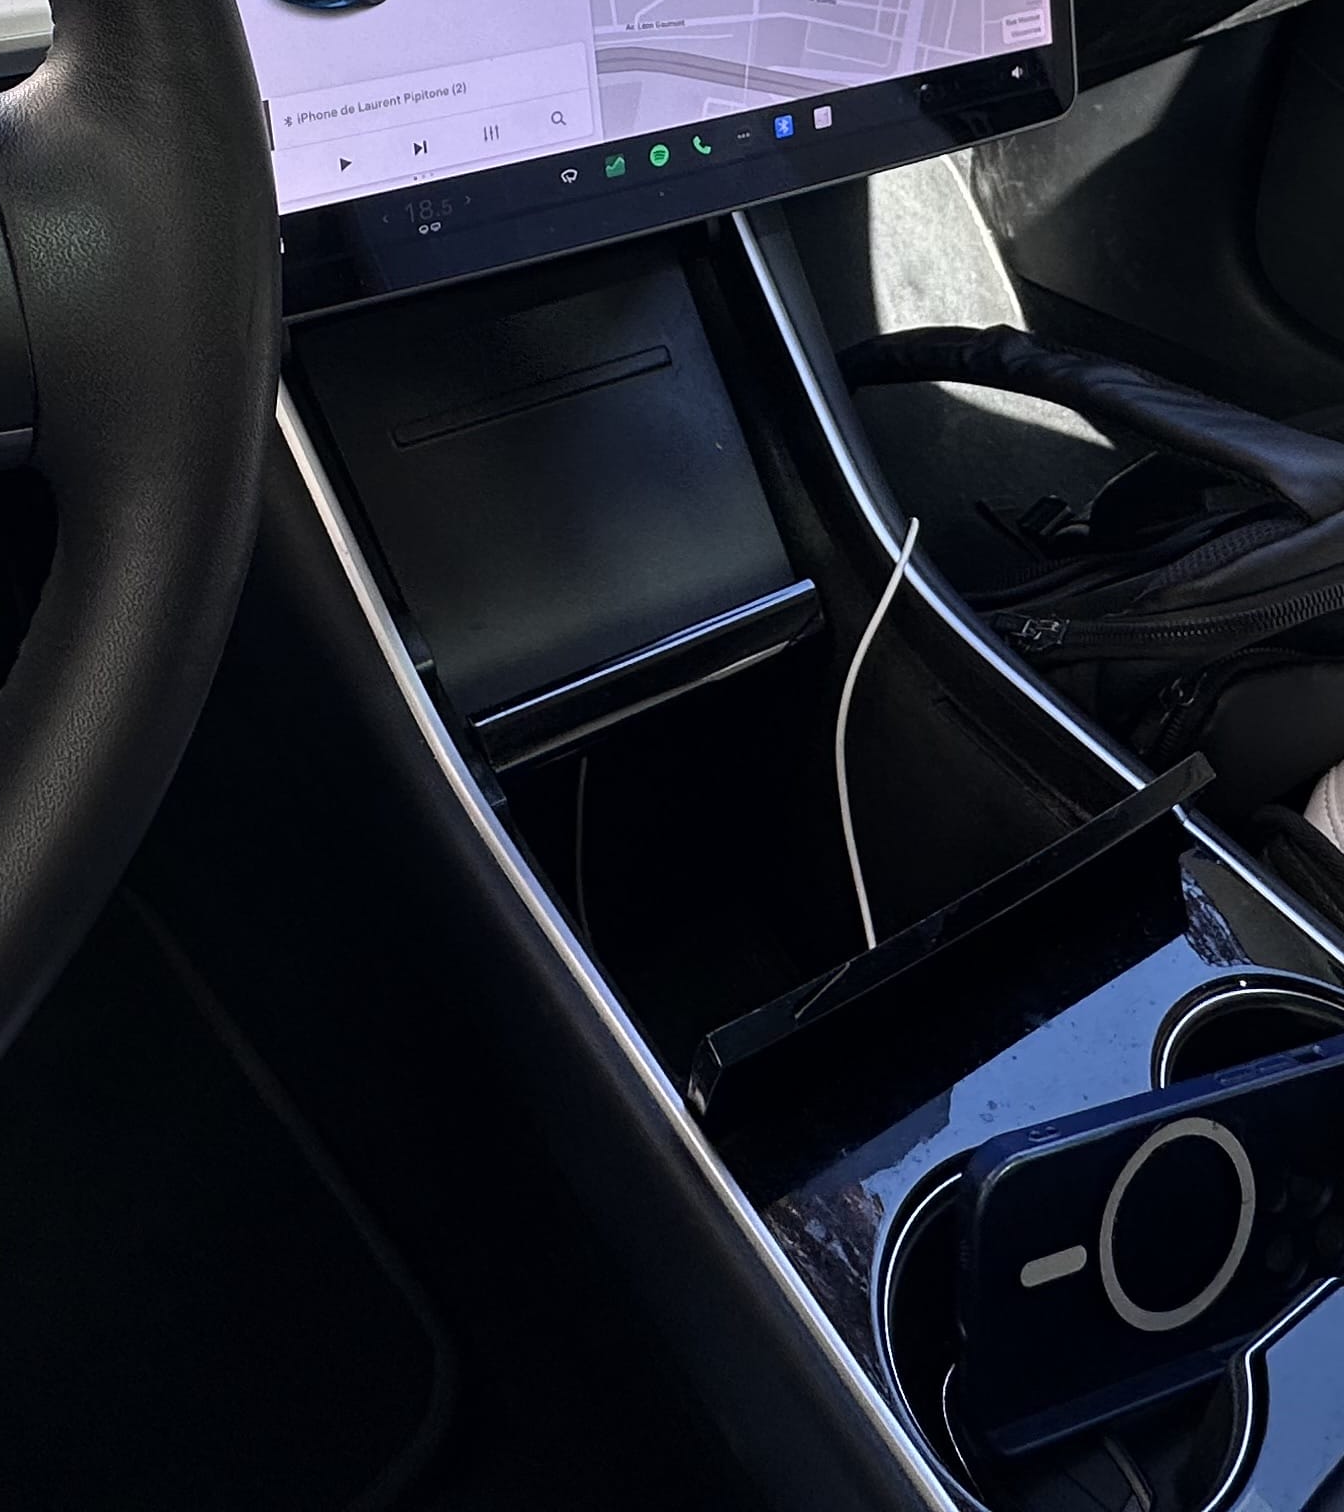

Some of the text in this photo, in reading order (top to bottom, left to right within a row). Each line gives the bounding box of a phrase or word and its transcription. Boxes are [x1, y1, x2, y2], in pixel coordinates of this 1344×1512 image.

[297, 82, 467, 125] iPhone de Laurent Pipitone (2)
[404, 198, 454, 223] 18.5
